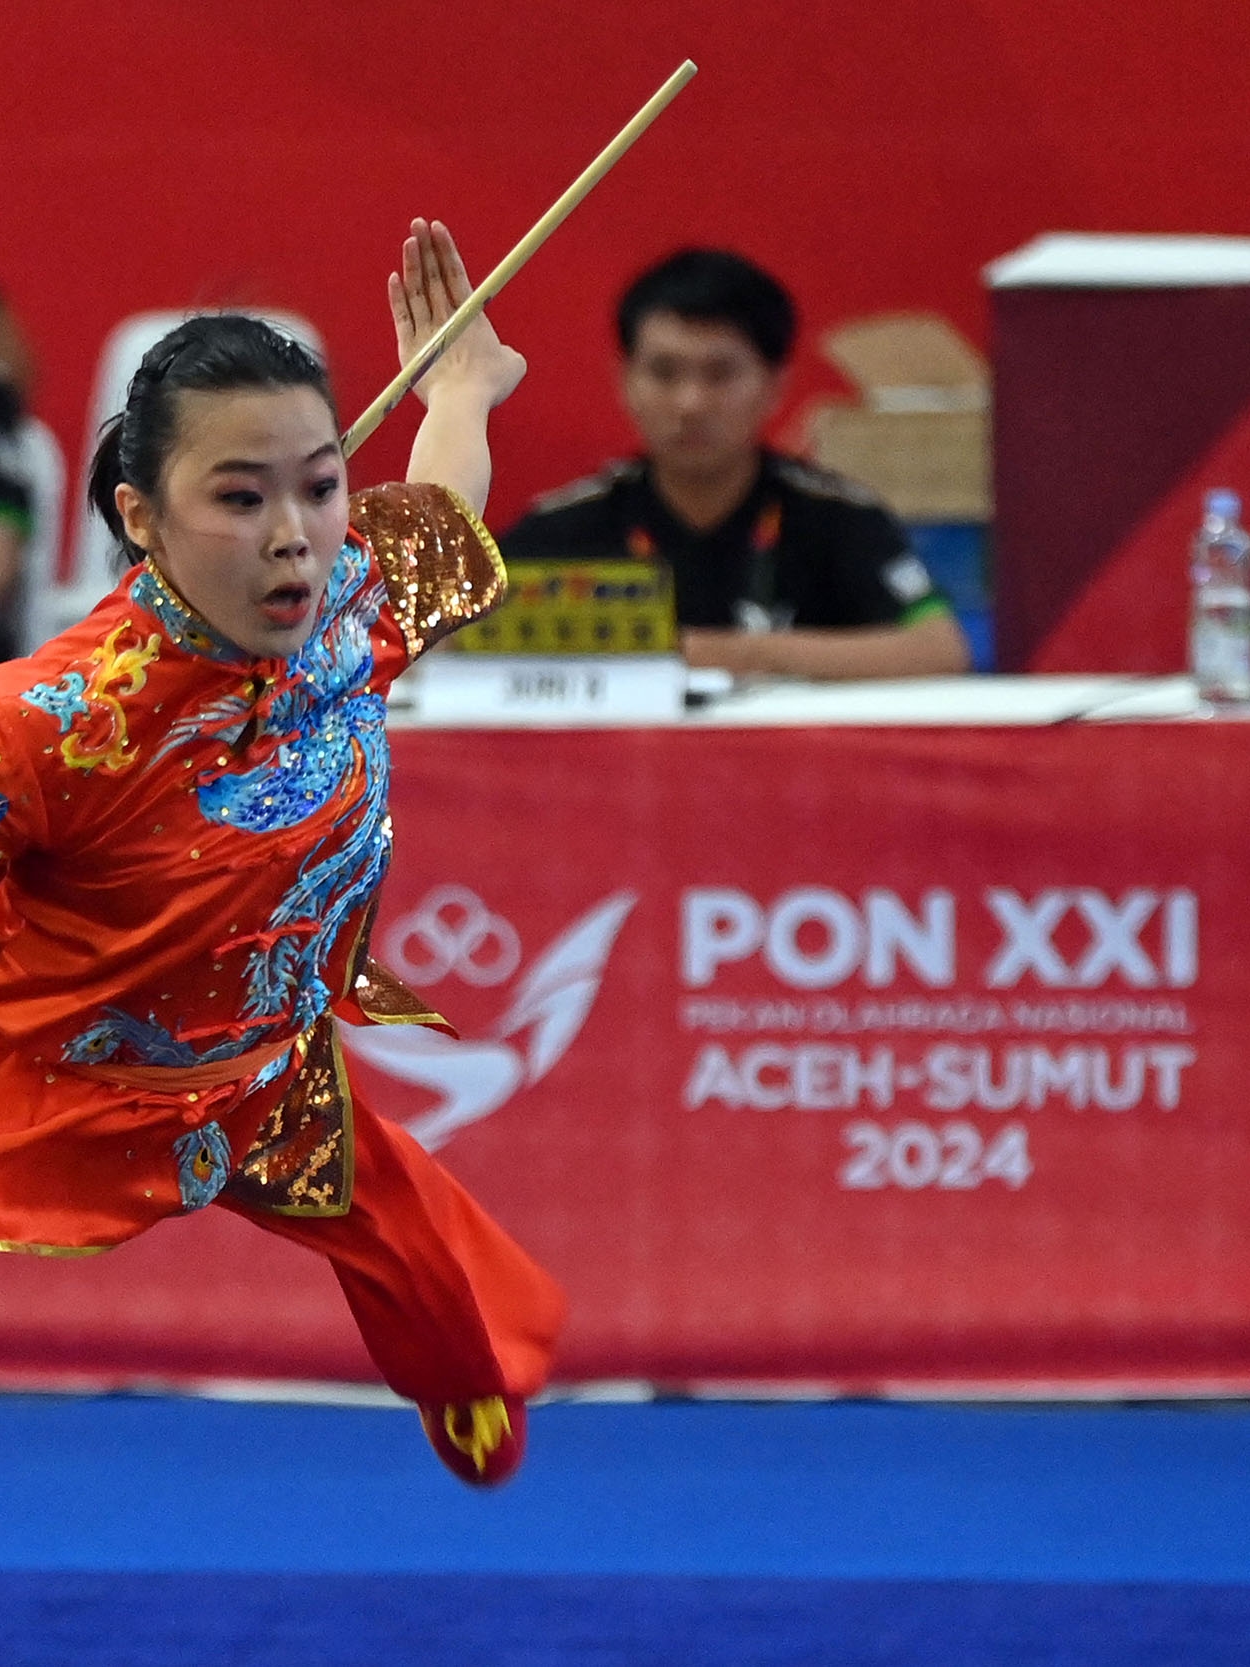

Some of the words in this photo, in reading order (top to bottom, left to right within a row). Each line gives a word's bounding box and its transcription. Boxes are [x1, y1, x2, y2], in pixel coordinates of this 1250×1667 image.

[680, 886, 955, 988] PON
[984, 888, 1198, 988] XXI
[684, 1042, 1195, 1110] ACEH-SUMUT
[840, 1120, 1033, 1188] 2024
